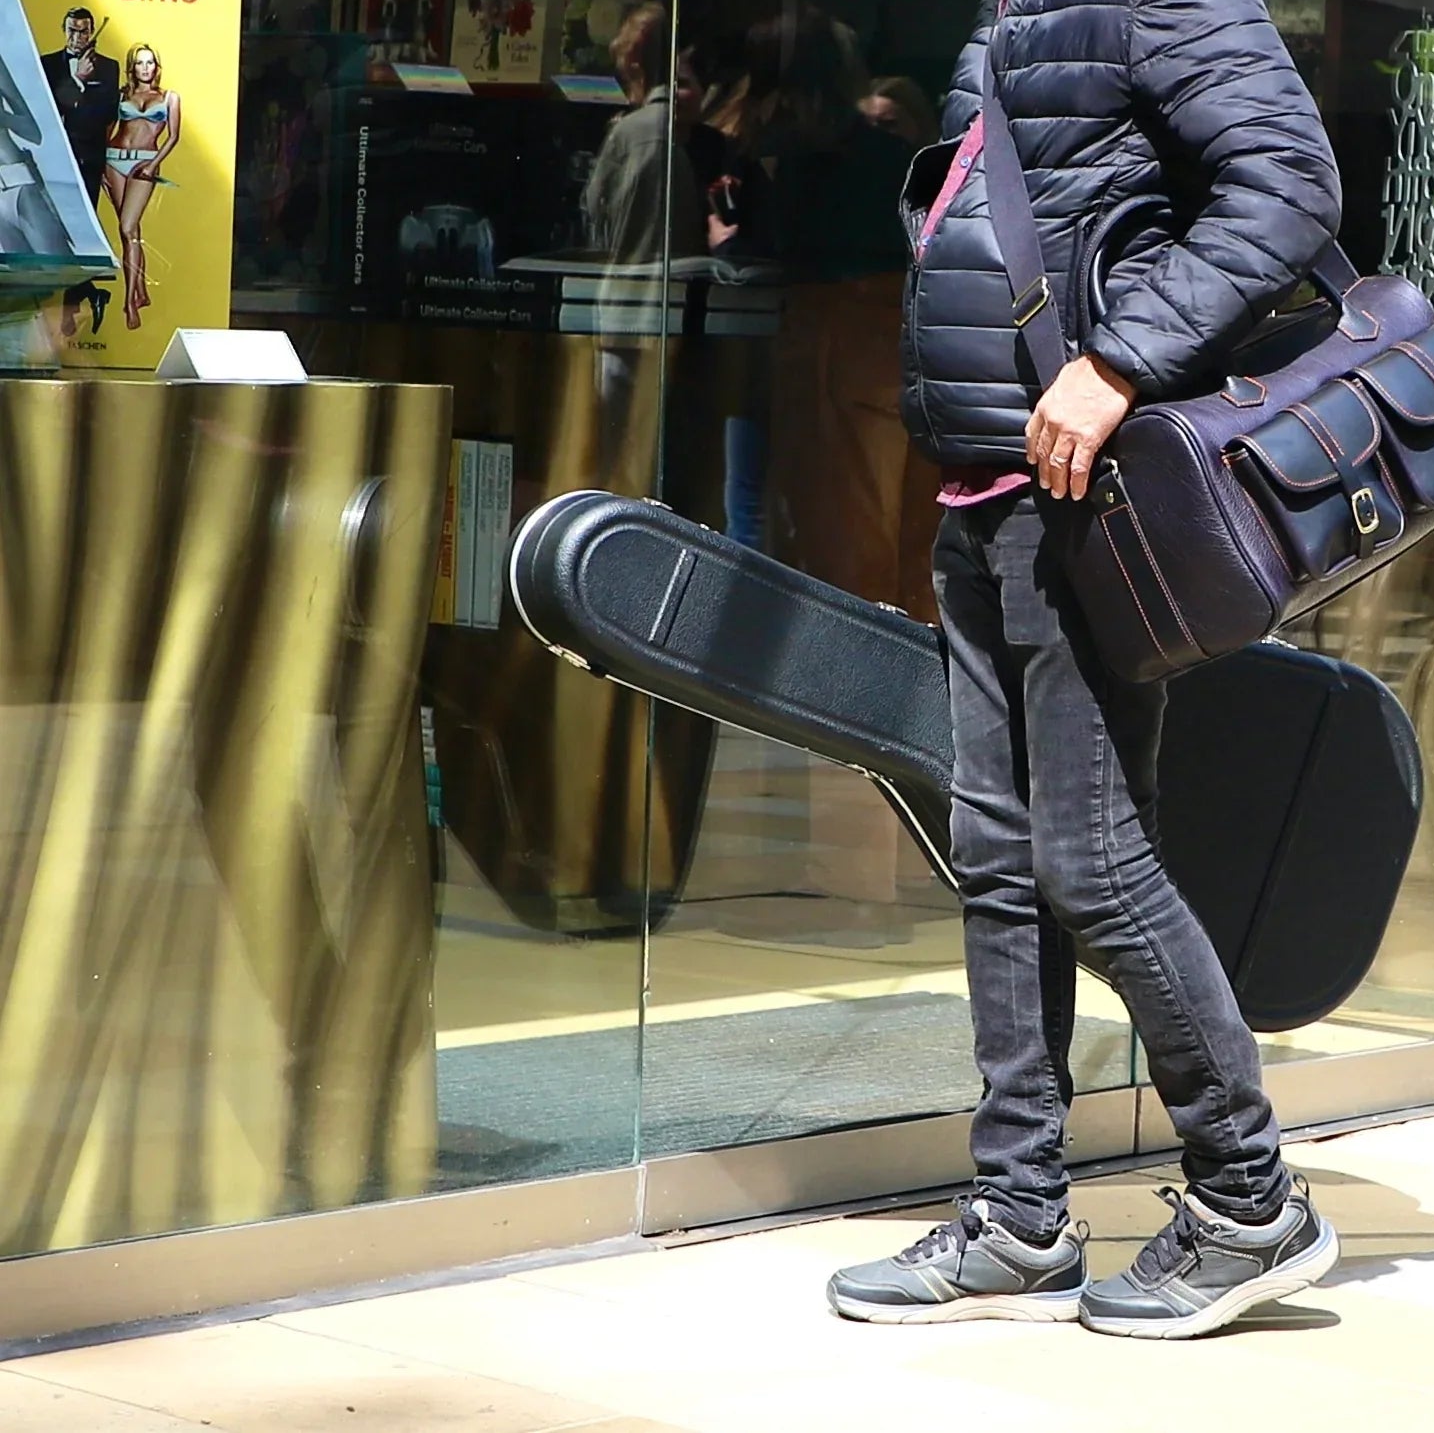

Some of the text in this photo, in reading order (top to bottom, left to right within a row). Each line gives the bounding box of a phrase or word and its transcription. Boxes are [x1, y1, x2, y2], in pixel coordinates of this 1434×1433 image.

[353, 126, 369, 285] Ultimate Collector Cars
[424, 275, 466, 288] Ultimate
[466, 277, 512, 292] Collector
[512, 279, 536, 293] Cars
[420, 304, 462, 318] Ultimate
[462, 306, 508, 321] Collector
[508, 309, 533, 323] Cars
[67, 340, 107, 351] TASCHEN
